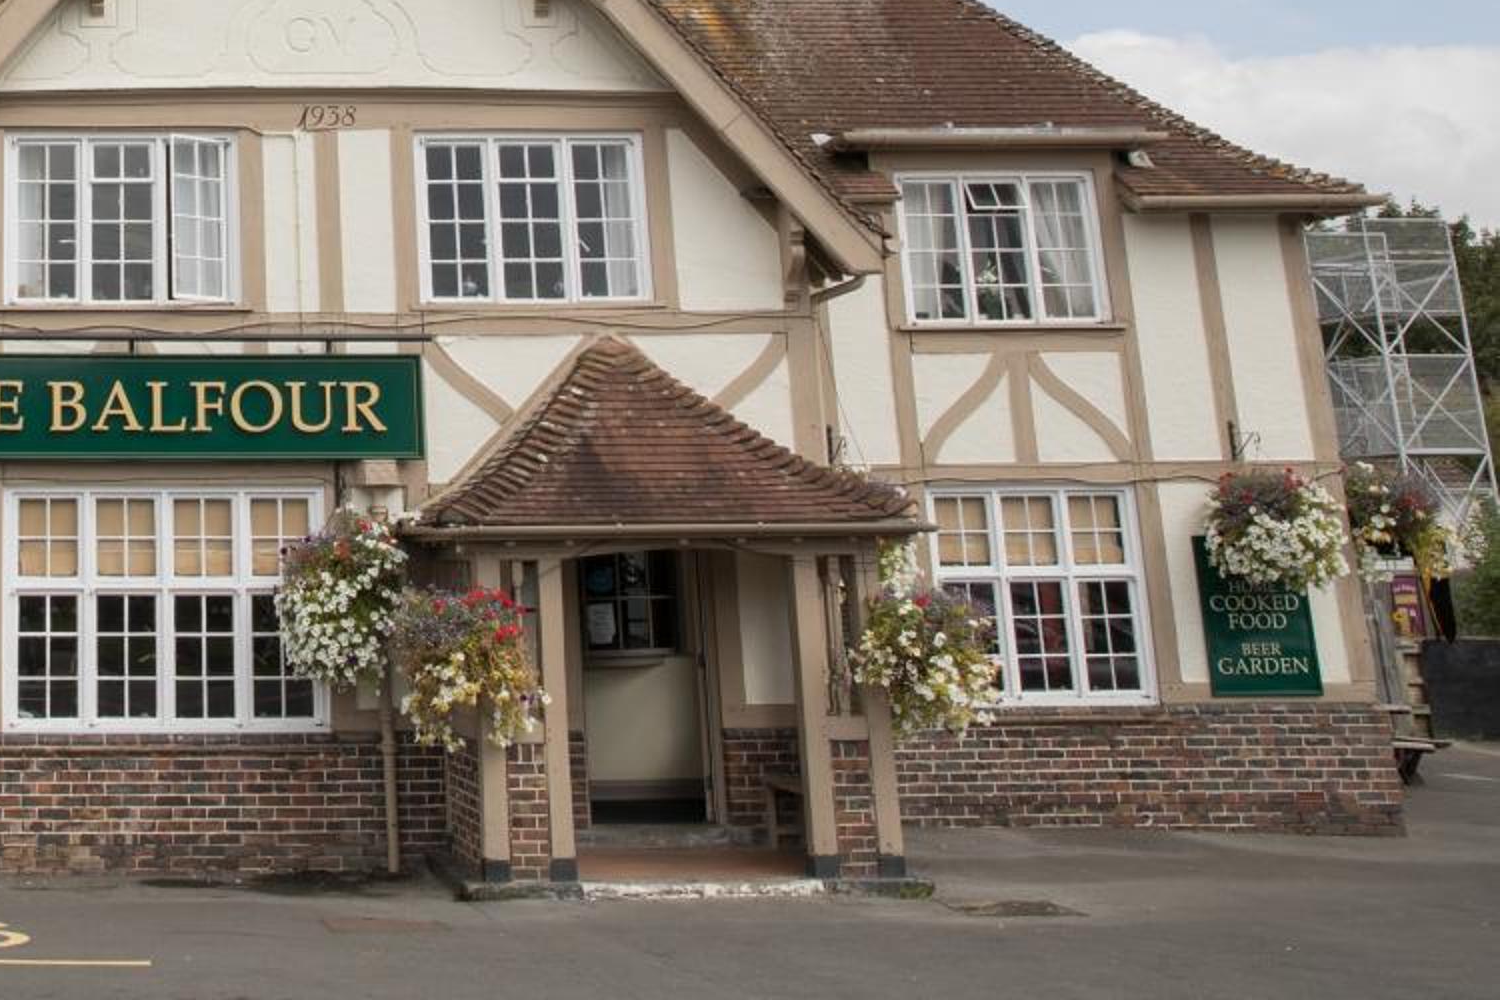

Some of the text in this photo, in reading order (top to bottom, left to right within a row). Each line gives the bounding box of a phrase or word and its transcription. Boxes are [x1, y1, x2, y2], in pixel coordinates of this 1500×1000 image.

[297, 104, 357, 128] 1938
[46, 379, 388, 433] BALFOUR
[1208, 593, 1300, 612] COOKED
[1227, 612, 1288, 630] FOOD
[1241, 641, 1282, 656] BEER
[1217, 656, 1310, 675] GARDEN
